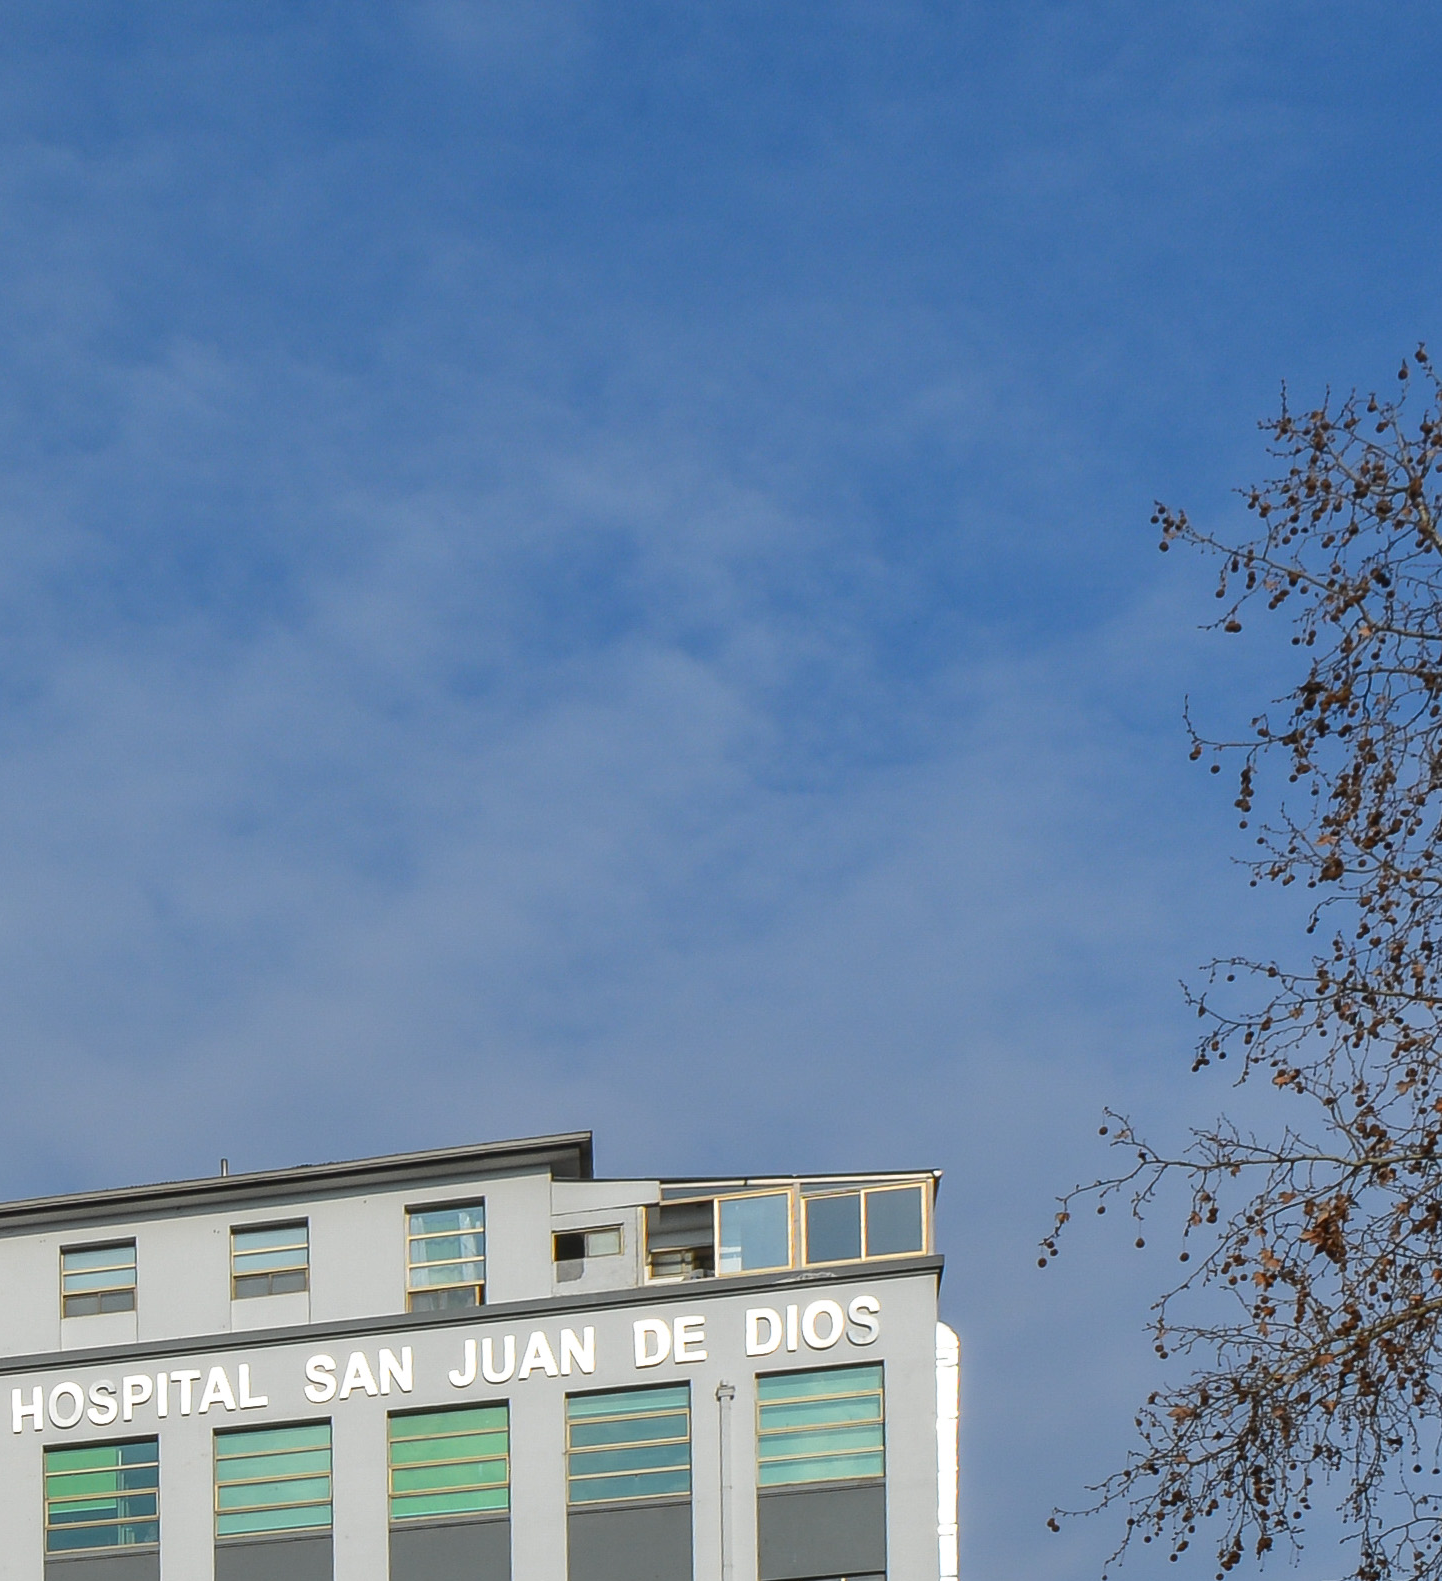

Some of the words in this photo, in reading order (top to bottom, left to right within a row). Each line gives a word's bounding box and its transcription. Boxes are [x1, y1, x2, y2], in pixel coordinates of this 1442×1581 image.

[11, 1364, 269, 1433] HOSPITAL
[304, 1346, 414, 1403] SAN
[448, 1325, 596, 1387] JUAN
[633, 1315, 707, 1366] DE
[745, 1295, 880, 1357] DIOS
